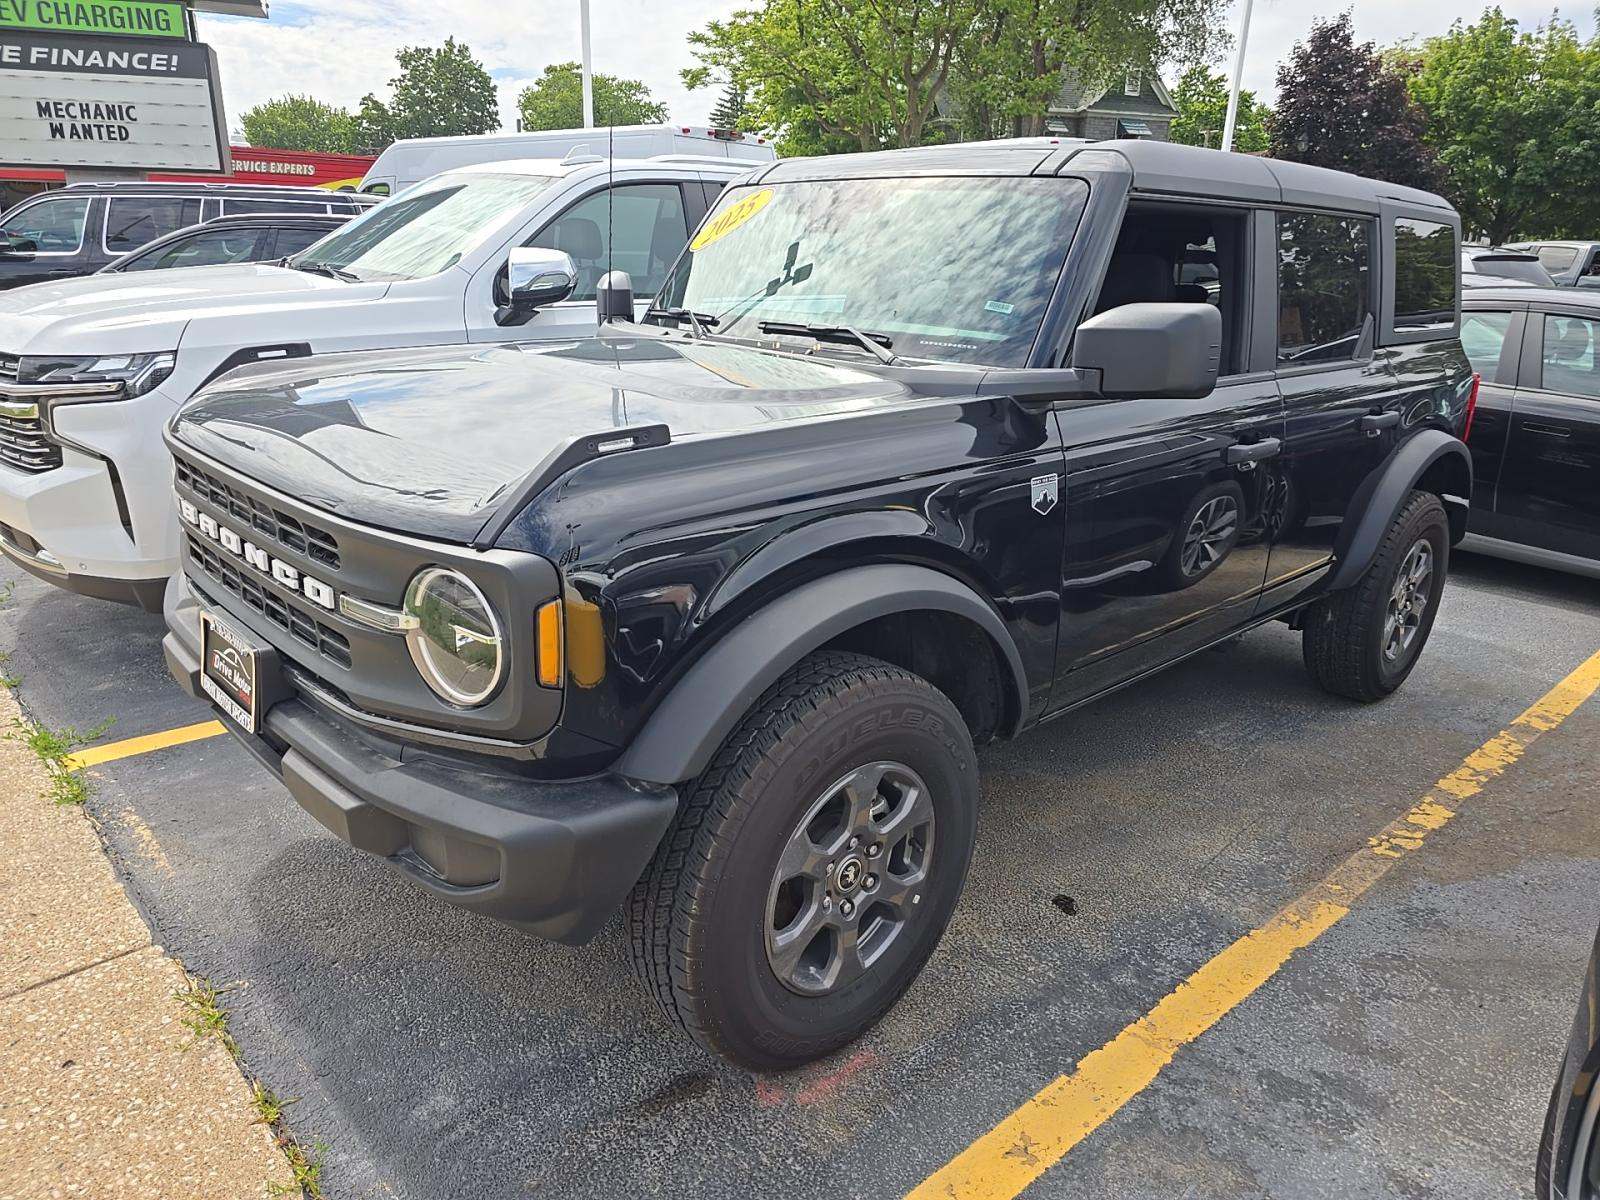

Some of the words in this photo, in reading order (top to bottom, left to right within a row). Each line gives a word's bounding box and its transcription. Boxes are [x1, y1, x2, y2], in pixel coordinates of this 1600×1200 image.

[36, 0, 171, 31] CHARGING
[0, 45, 21, 63] E
[30, 48, 179, 71] FINANCE!
[36, 101, 138, 121] MECHANIC
[49, 122, 130, 141] WANTED
[270, 162, 315, 175] EXPERTS
[700, 194, 761, 245] 2025
[179, 498, 335, 609] BRONCO
